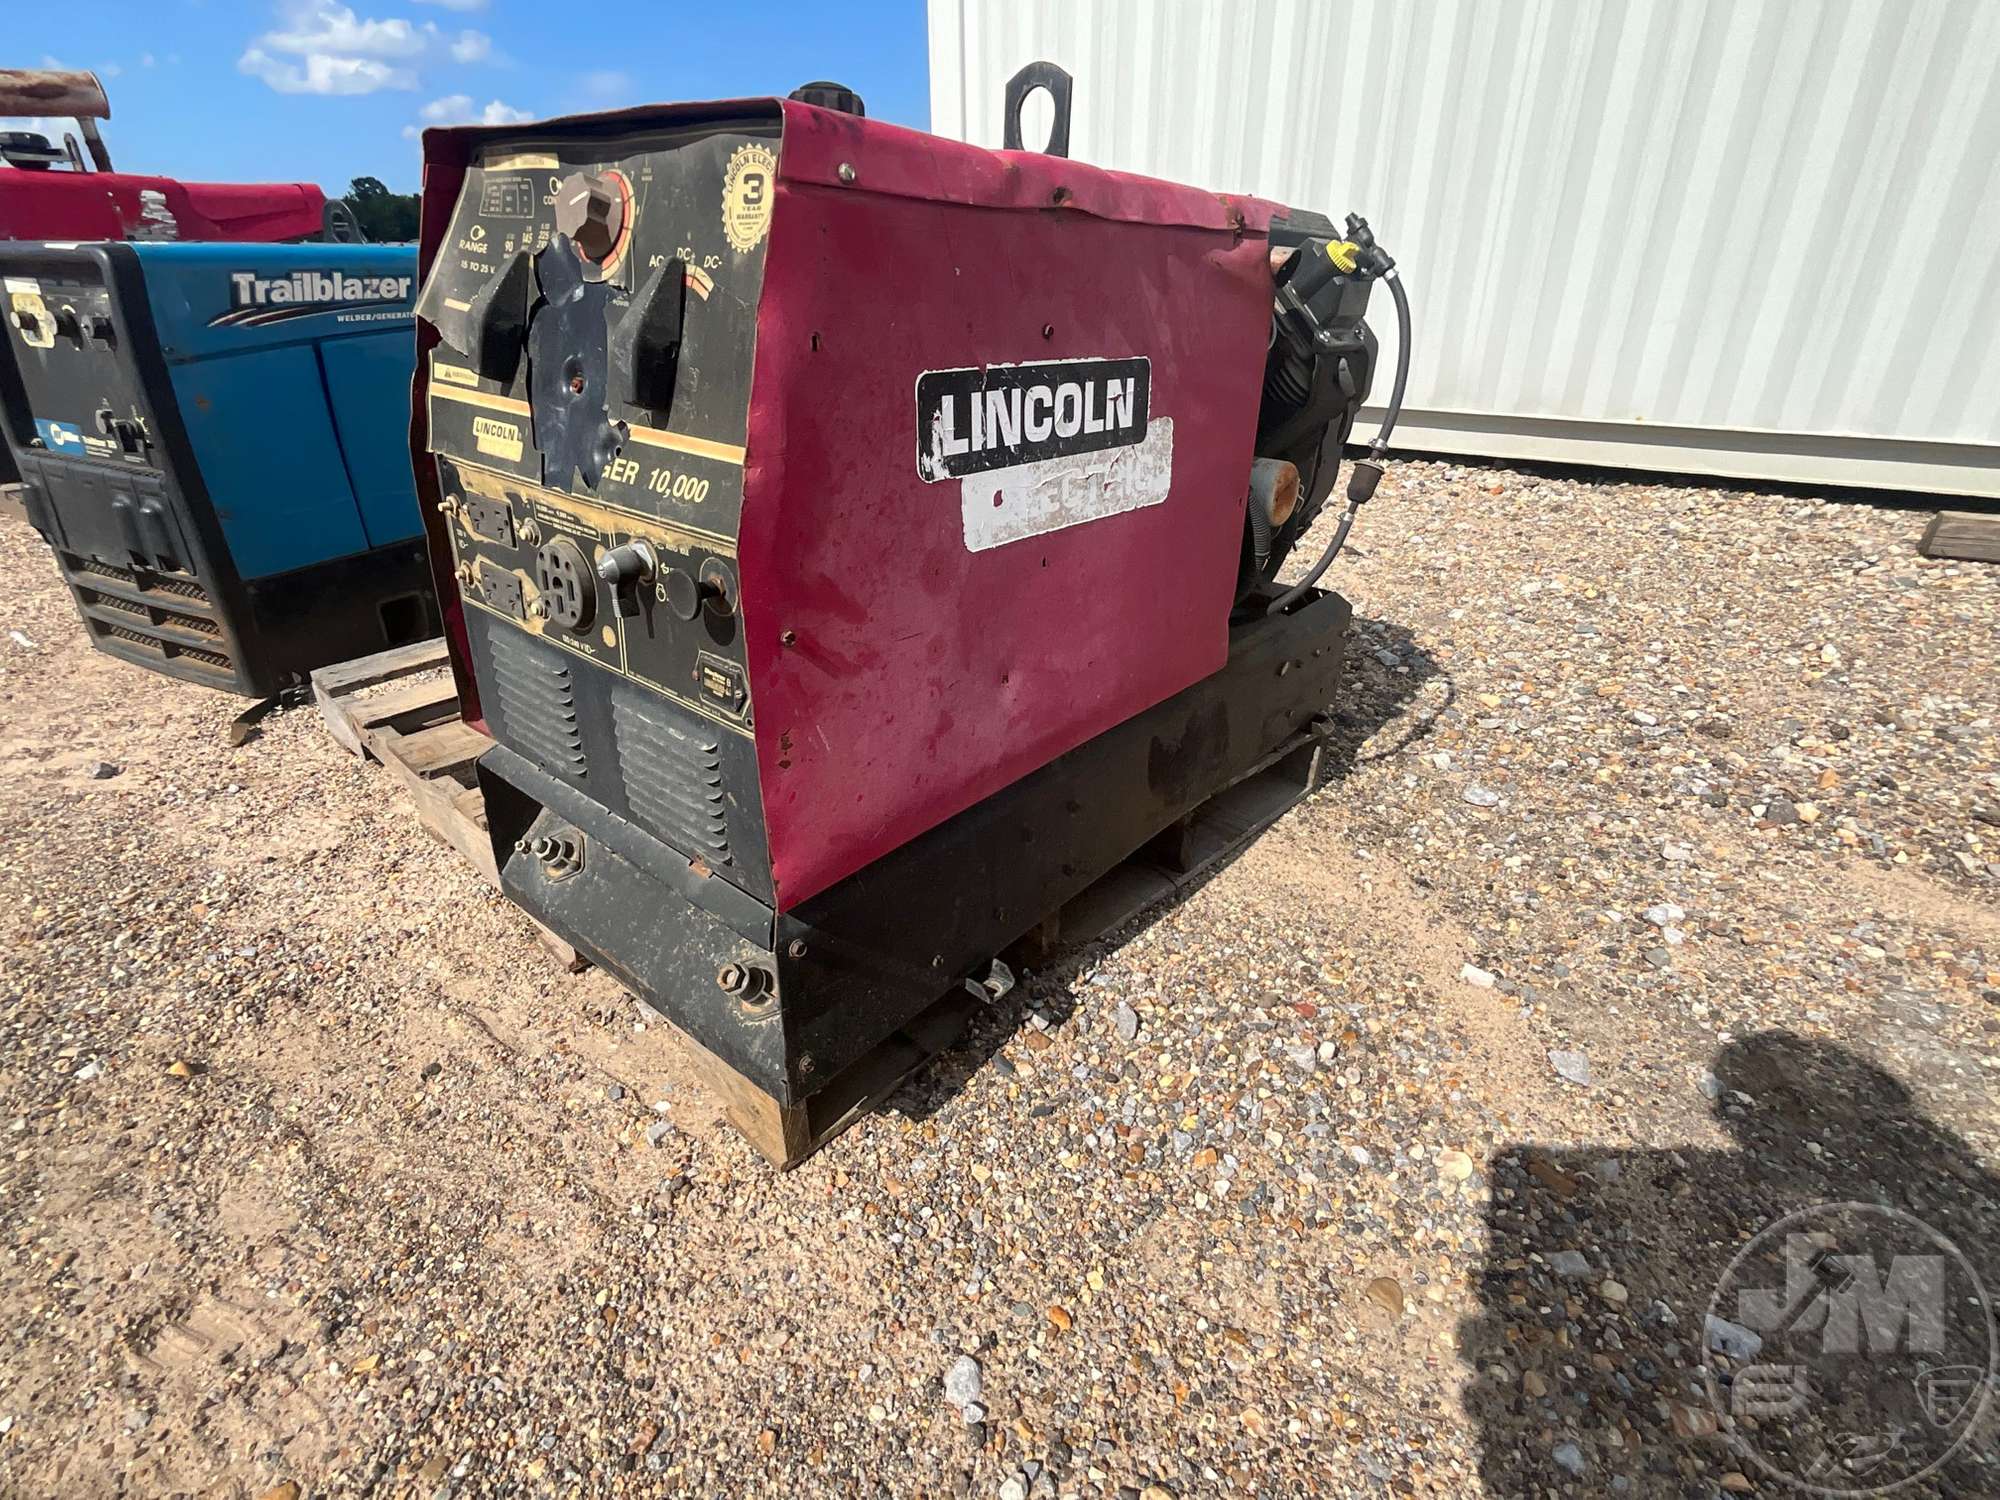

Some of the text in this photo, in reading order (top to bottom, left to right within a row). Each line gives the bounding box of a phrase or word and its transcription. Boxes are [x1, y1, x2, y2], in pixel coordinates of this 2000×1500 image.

[727, 154, 750, 193] LINCOLN
[743, 173, 764, 205] 3
[459, 239, 488, 254] RANGE
[470, 261, 480, 272] TO
[480, 263, 489, 273] 25
[231, 271, 412, 305] Trailblazer
[475, 420, 515, 441] LINCOLN
[941, 377, 1135, 457] LINCOLN
[648, 467, 709, 503] 10,000
